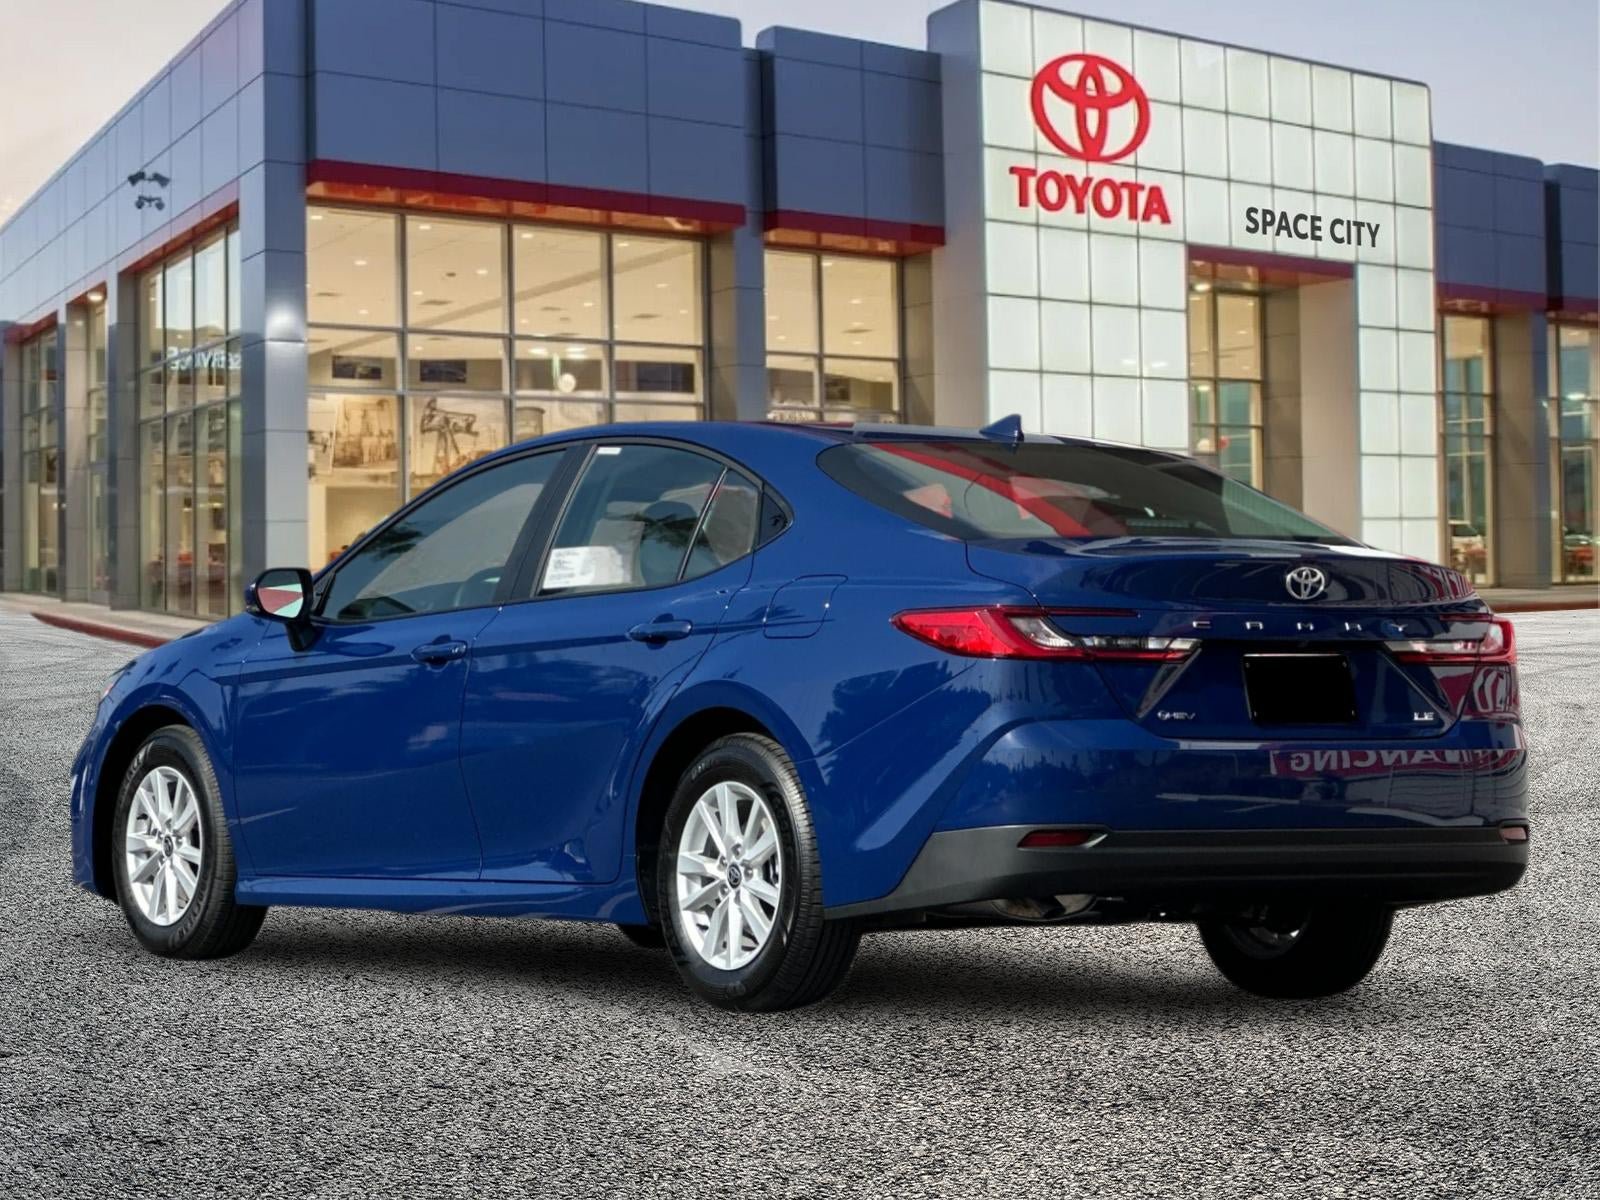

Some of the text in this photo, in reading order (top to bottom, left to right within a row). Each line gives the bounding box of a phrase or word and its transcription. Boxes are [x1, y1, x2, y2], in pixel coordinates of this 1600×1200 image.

[1009, 166, 1171, 224] TOYOTA
[1246, 207, 1380, 247] SPACE CITY
[1192, 620, 1408, 632] CAMRY
[1413, 711, 1434, 721] LE
